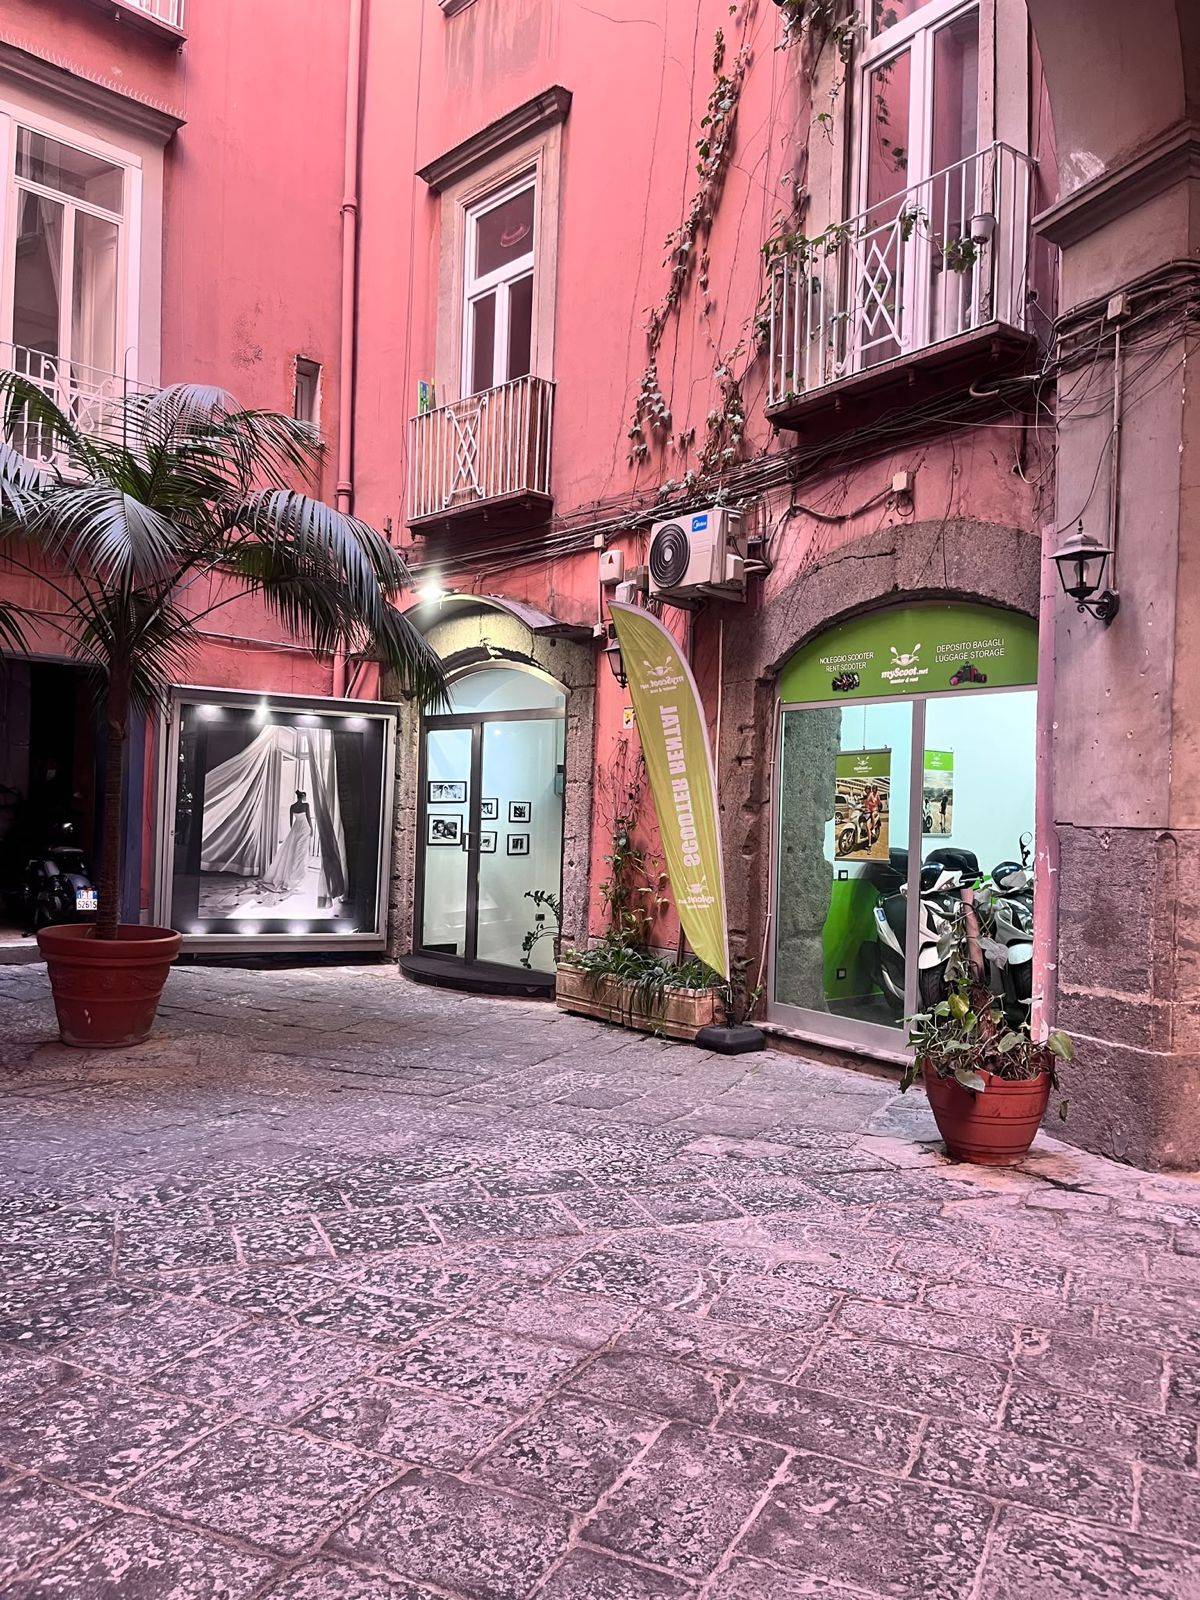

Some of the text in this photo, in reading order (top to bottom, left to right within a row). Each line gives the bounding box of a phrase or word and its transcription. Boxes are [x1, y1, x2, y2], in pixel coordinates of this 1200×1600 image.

[936, 638, 1005, 653] DEPOSITO BAGAGLI
[819, 652, 874, 664] NOLEGGIO SCOOTER
[935, 648, 1005, 663] LUGGAGE STORAGE
[825, 662, 867, 672] RENT SCOOTER
